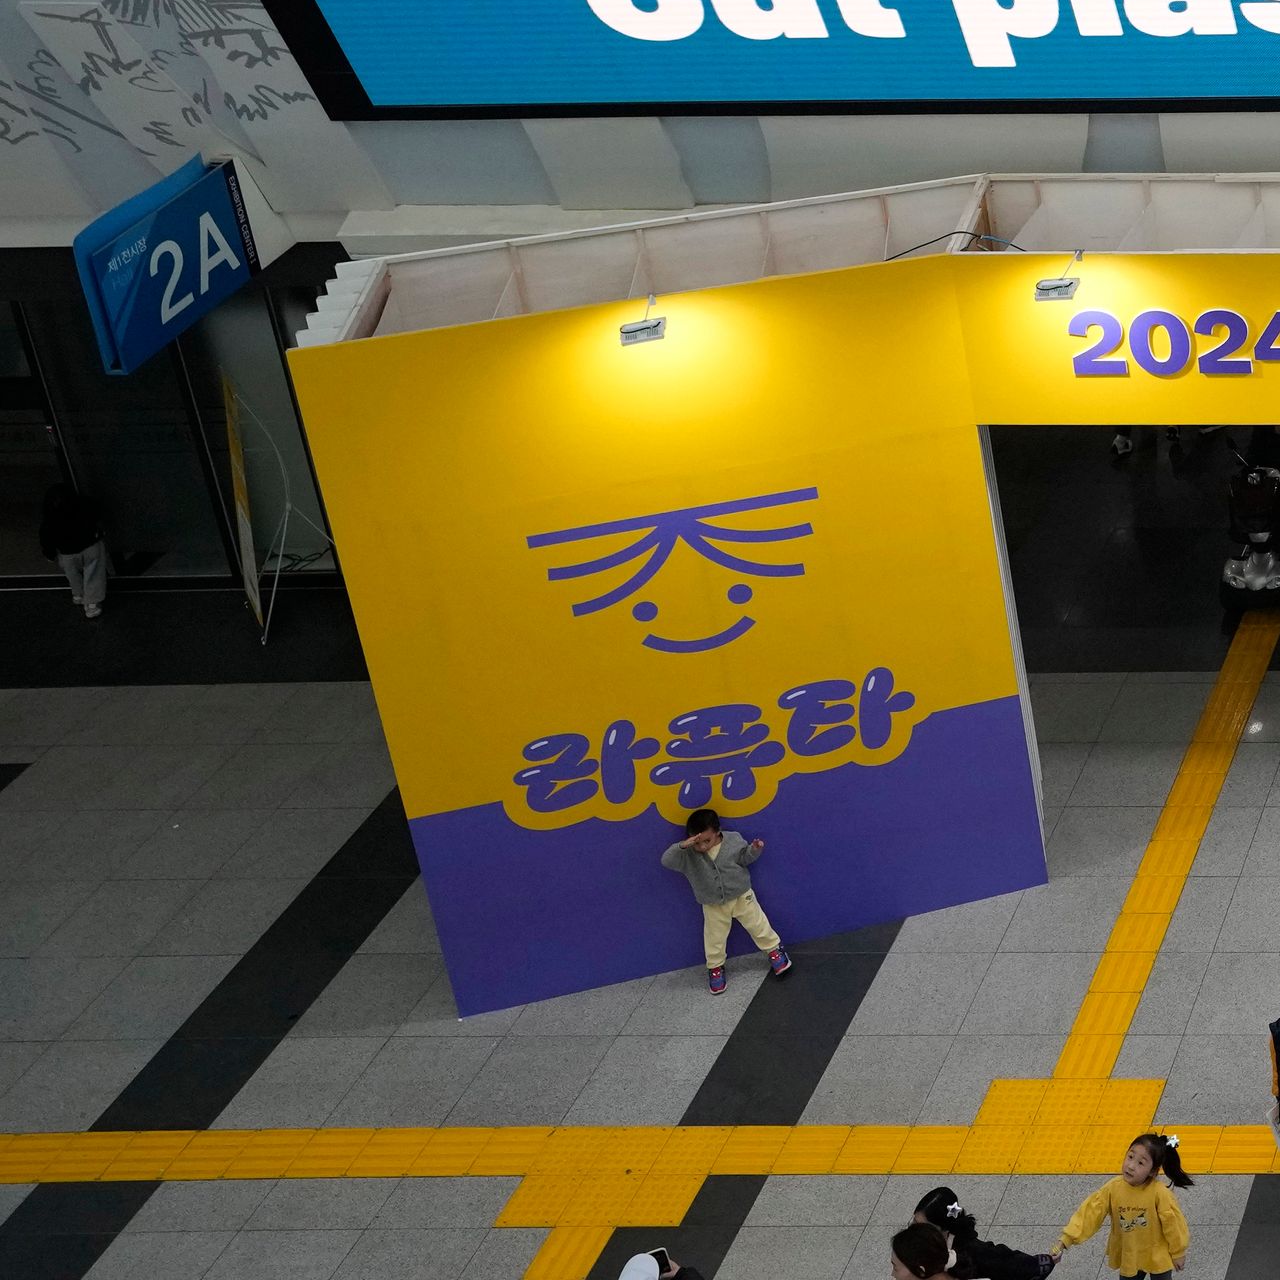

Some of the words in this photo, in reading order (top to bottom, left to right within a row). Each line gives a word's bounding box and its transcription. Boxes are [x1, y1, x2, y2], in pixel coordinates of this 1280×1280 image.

[228, 175, 247, 224] EXHIBITION
[149, 211, 241, 326] 2A
[513, 667, 916, 813] 라퓨타
